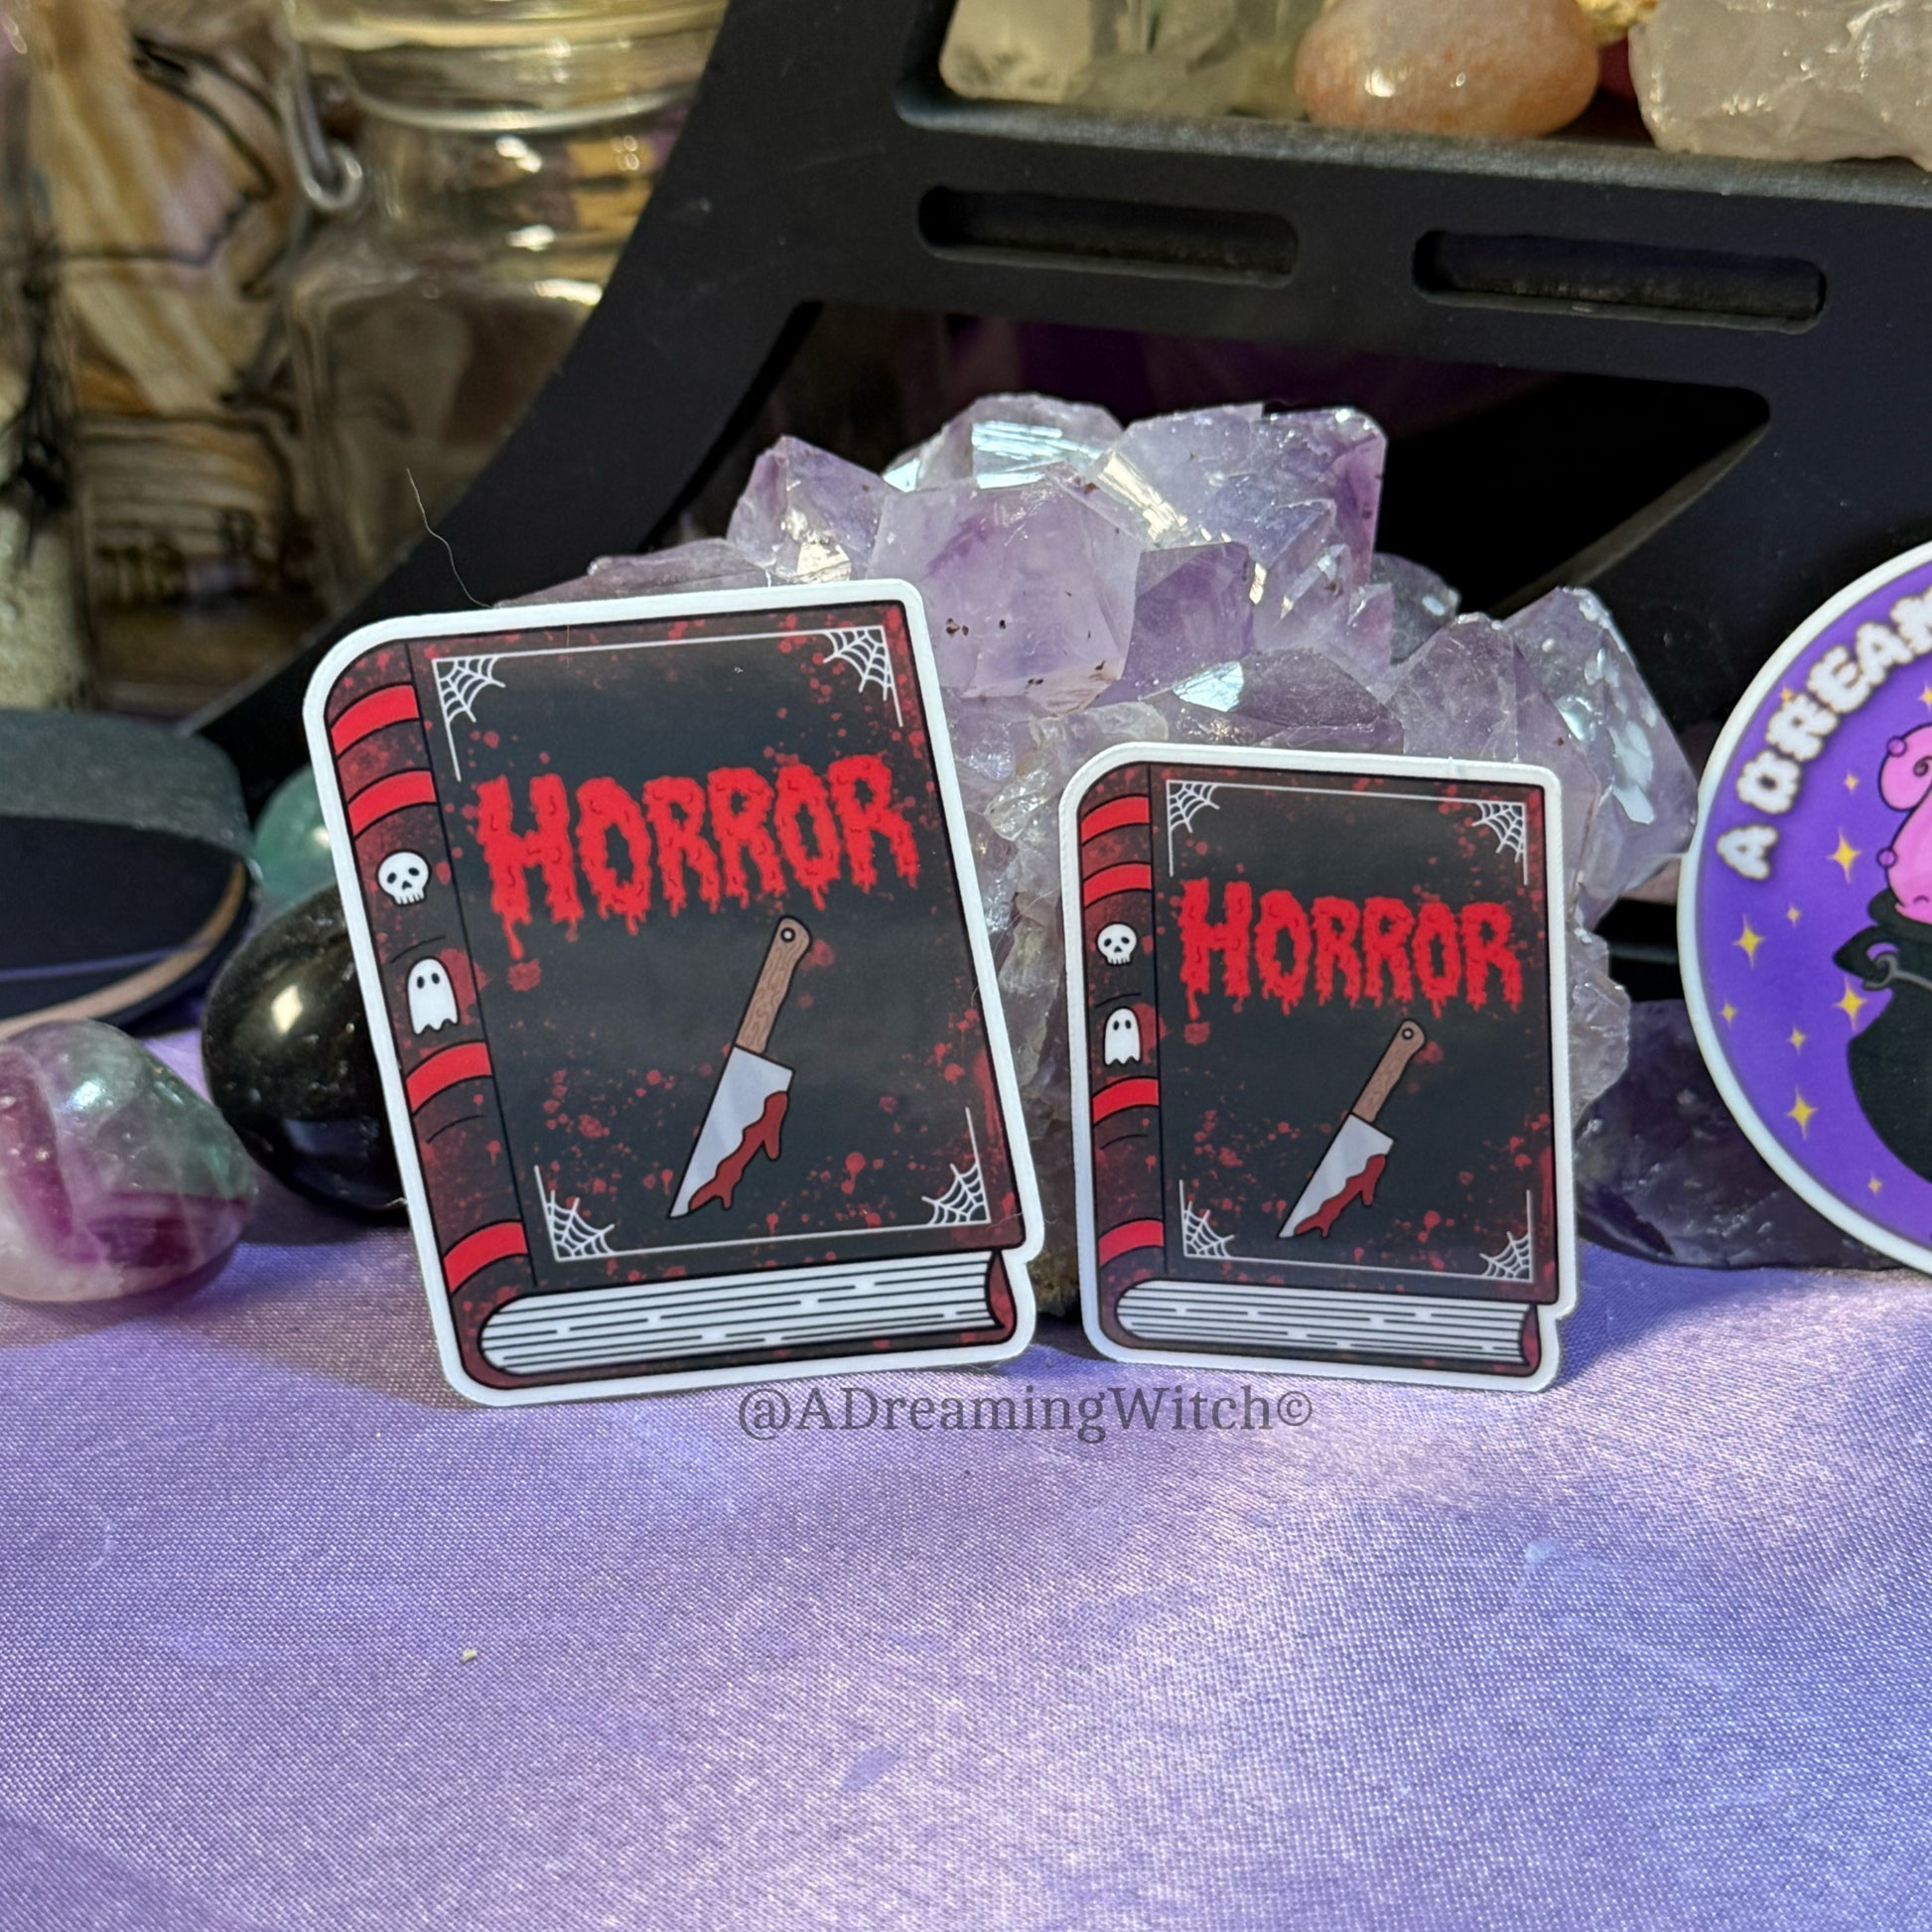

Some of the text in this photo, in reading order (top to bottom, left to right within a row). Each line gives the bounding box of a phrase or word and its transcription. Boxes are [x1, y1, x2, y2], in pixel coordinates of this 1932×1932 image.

[477, 755, 919, 959] HORROR
[1716, 824, 1778, 880] A
[1178, 877, 1523, 1020] HORROR
